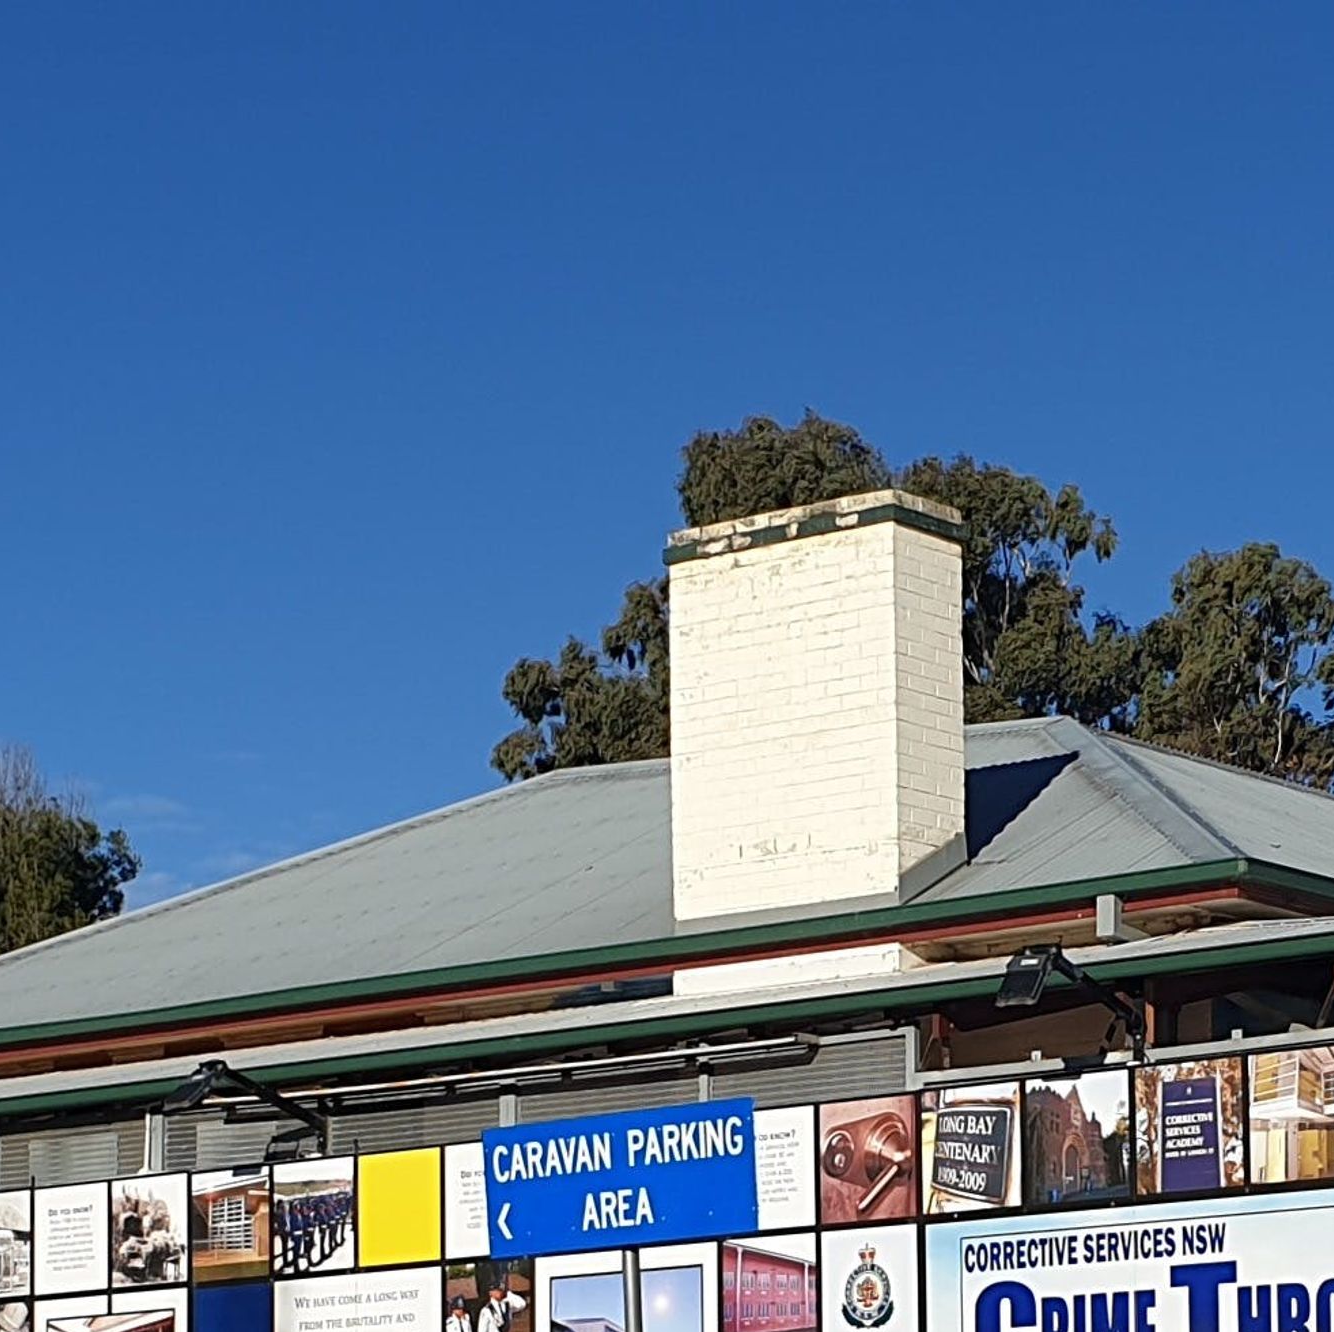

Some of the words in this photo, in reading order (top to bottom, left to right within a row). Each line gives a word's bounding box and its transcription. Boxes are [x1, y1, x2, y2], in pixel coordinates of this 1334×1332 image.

[939, 1115, 965, 1133] LONG
[967, 1115, 996, 1135] BAY
[492, 1132, 612, 1184] CARAVAN
[627, 1115, 743, 1167] PARKING
[582, 1187, 654, 1232] AREA
[965, 1236, 1078, 1273] CORRECTIVE
[1083, 1227, 1176, 1264] SERVICES
[1182, 1222, 1226, 1256] NSW
[295, 1297, 310, 1308] WE
[313, 1296, 336, 1308] HAVE
[338, 1294, 363, 1305] COME
[366, 1294, 371, 1303] A
[374, 1291, 397, 1302] LONG
[299, 1320, 323, 1332] FROM
[326, 1318, 343, 1329] THE
[345, 1314, 393, 1328] BRUTALITY
[396, 1313, 415, 1323] AND
